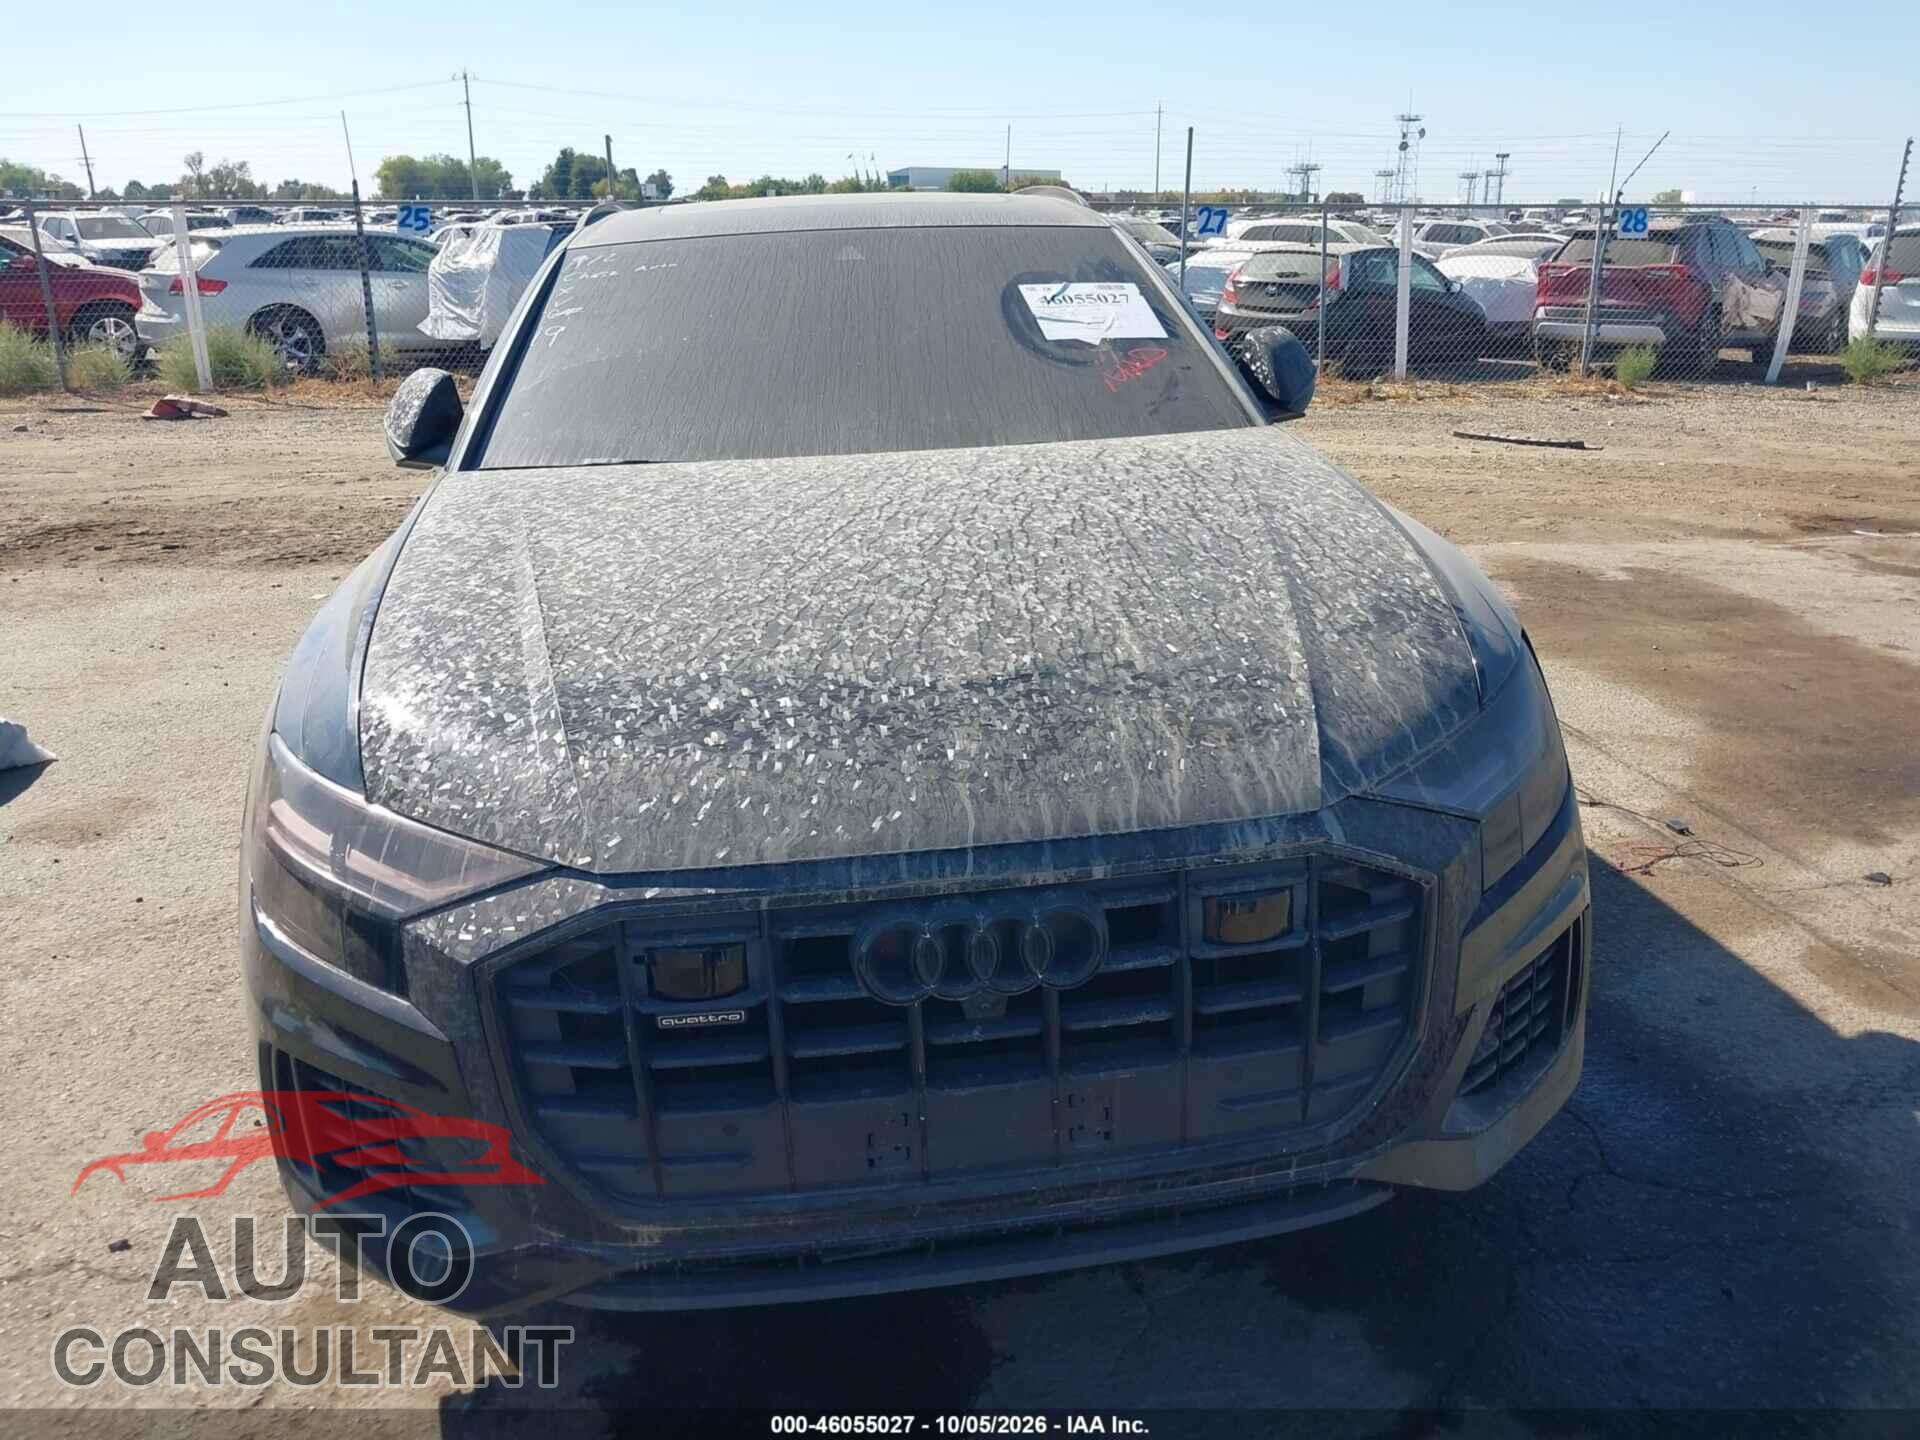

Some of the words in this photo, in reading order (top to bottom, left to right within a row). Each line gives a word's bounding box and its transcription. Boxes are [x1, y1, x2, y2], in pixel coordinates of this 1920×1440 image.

[399, 206, 430, 231] 25
[1199, 207, 1227, 234] 27
[1621, 208, 1647, 233] 28
[662, 1014, 740, 1027] quattro
